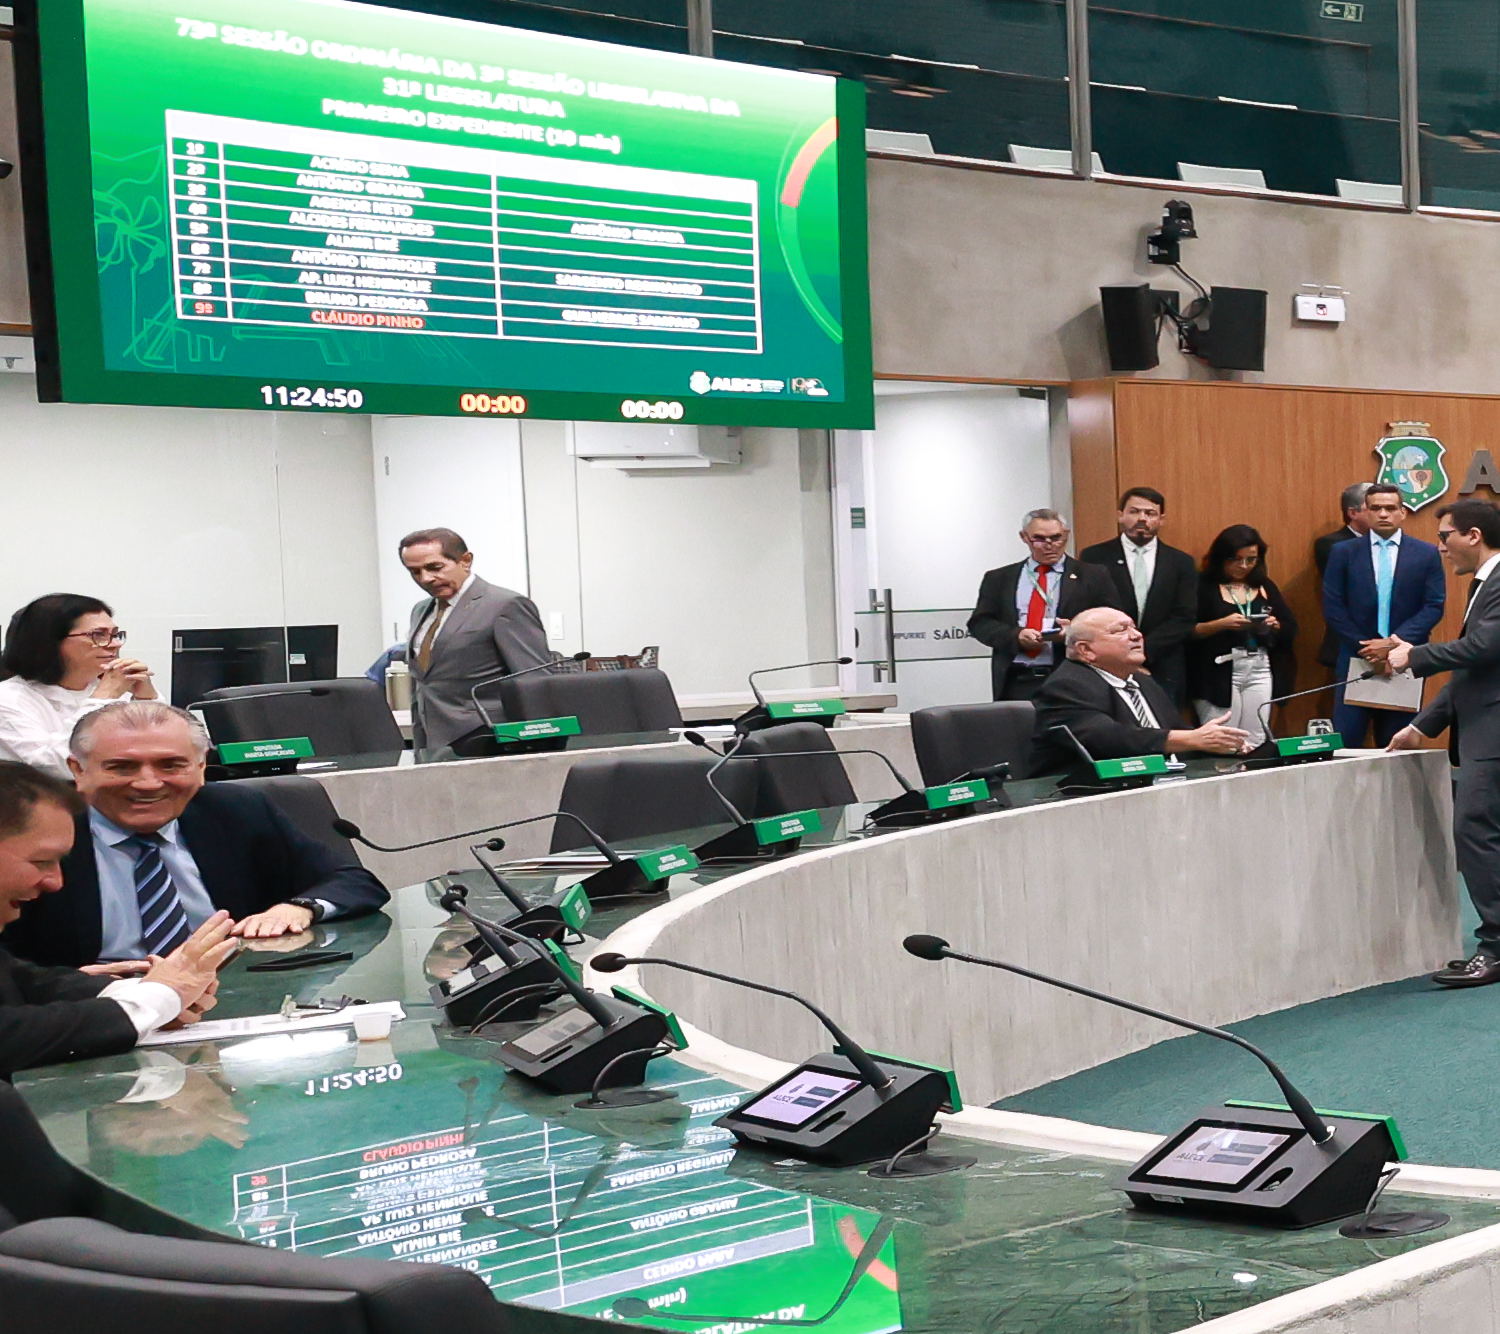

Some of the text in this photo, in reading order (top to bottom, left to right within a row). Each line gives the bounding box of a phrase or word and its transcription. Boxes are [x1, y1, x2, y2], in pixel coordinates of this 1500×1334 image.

[221, 24, 308, 55] SESSÃO
[311, 40, 441, 76] ORDINÁRIA
[443, 59, 477, 80] DA
[425, 82, 566, 118] LEGISLATURA
[321, 98, 426, 127] PRIMEIRO
[427, 111, 544, 142] EXPEDIENTE
[311, 310, 424, 329] CLÁUDIO PINHO
[261, 385, 364, 409] 11:24:50
[460, 393, 527, 414] 00:00
[621, 399, 684, 420] 00:00
